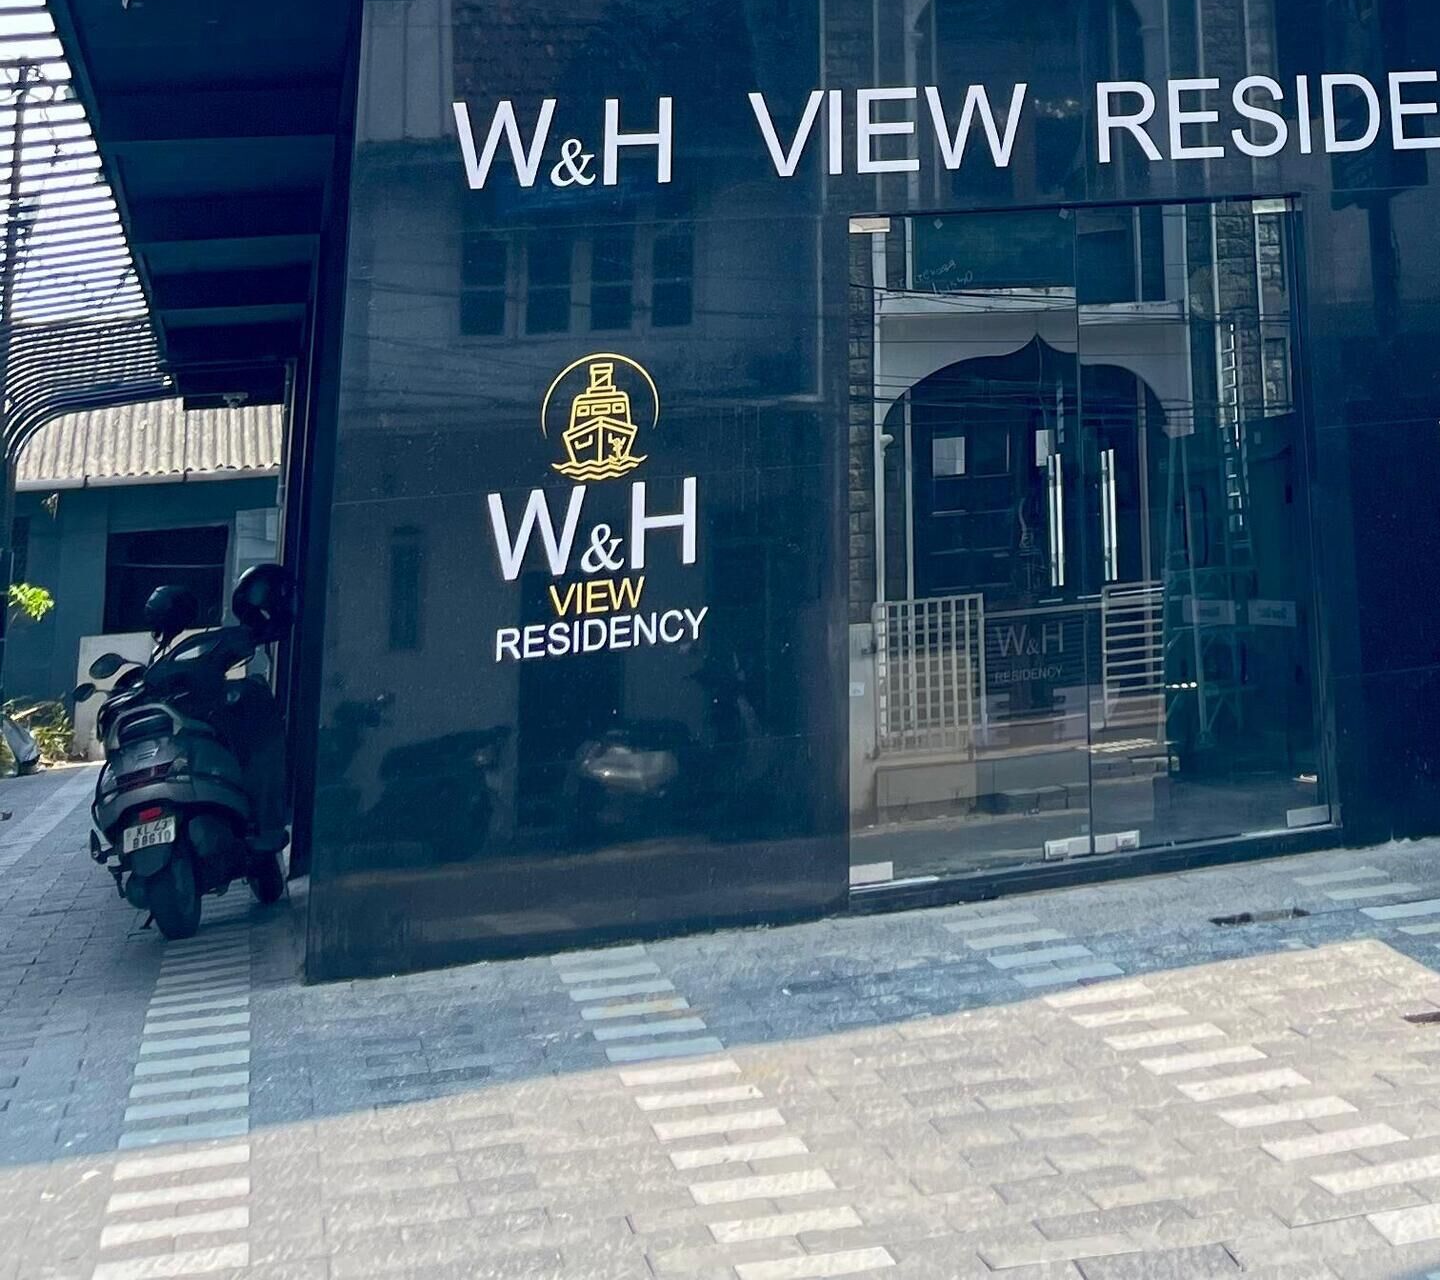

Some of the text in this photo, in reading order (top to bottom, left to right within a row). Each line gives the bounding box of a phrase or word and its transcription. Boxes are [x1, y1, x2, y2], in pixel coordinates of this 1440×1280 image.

[452, 96, 672, 190] W&H
[747, 83, 1028, 178] VIEW
[487, 476, 697, 581] W&H
[495, 607, 709, 663] RESIDENCY
[549, 576, 645, 617] VIEW
